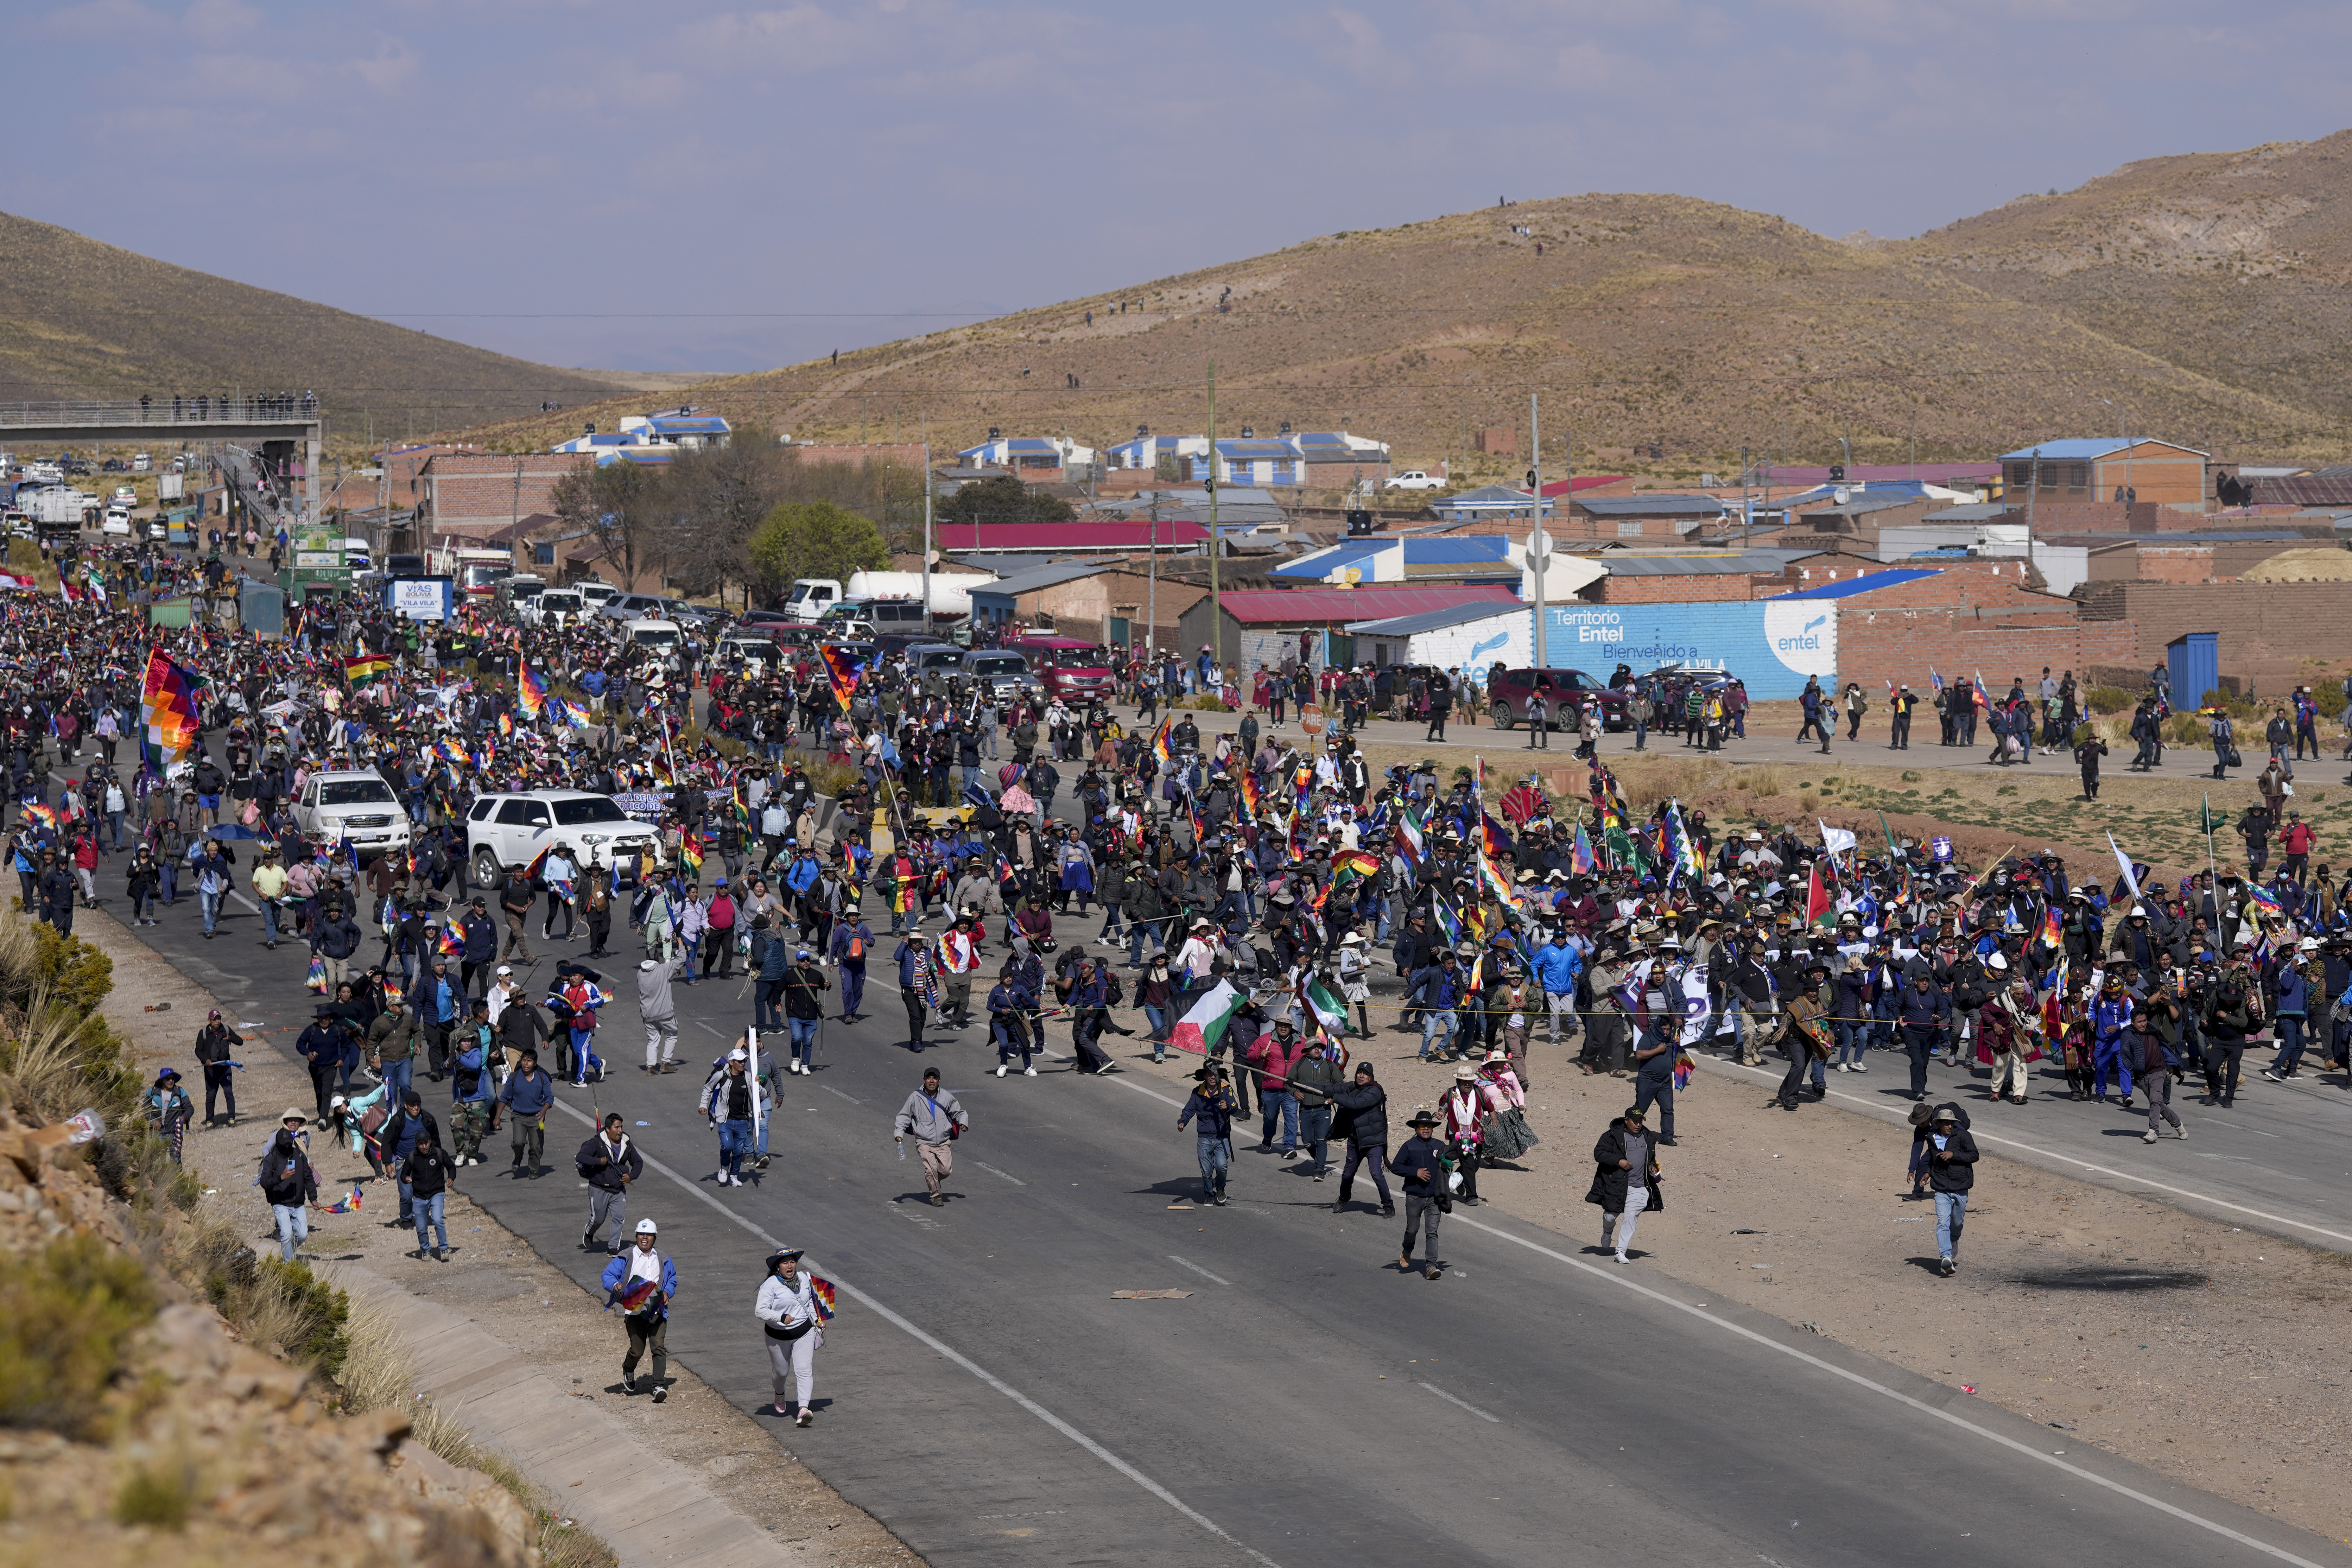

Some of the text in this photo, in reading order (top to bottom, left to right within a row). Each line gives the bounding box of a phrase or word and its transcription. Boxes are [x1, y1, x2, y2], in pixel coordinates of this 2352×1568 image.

[1579, 626, 1623, 642] Entel
[1779, 634, 1820, 650] entel
[1604, 644, 1698, 659] Bienvenido a
[1302, 712, 1321, 726] PARE
[634, 793, 647, 801] DE
[647, 793, 663, 802] LAS
